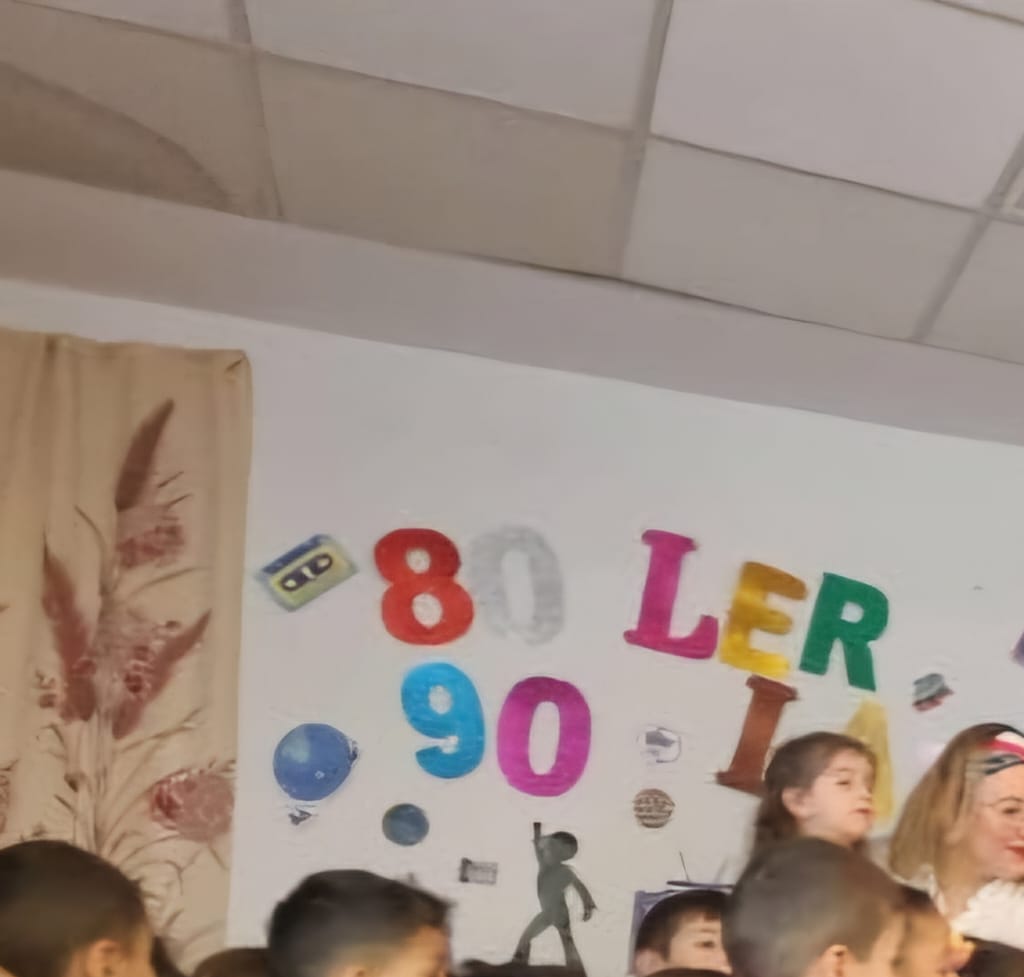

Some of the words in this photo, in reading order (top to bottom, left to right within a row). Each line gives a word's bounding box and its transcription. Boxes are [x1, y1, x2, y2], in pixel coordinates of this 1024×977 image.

[374, 527, 564, 646] 80
[623, 529, 888, 692] LER
[401, 661, 592, 797] 90
